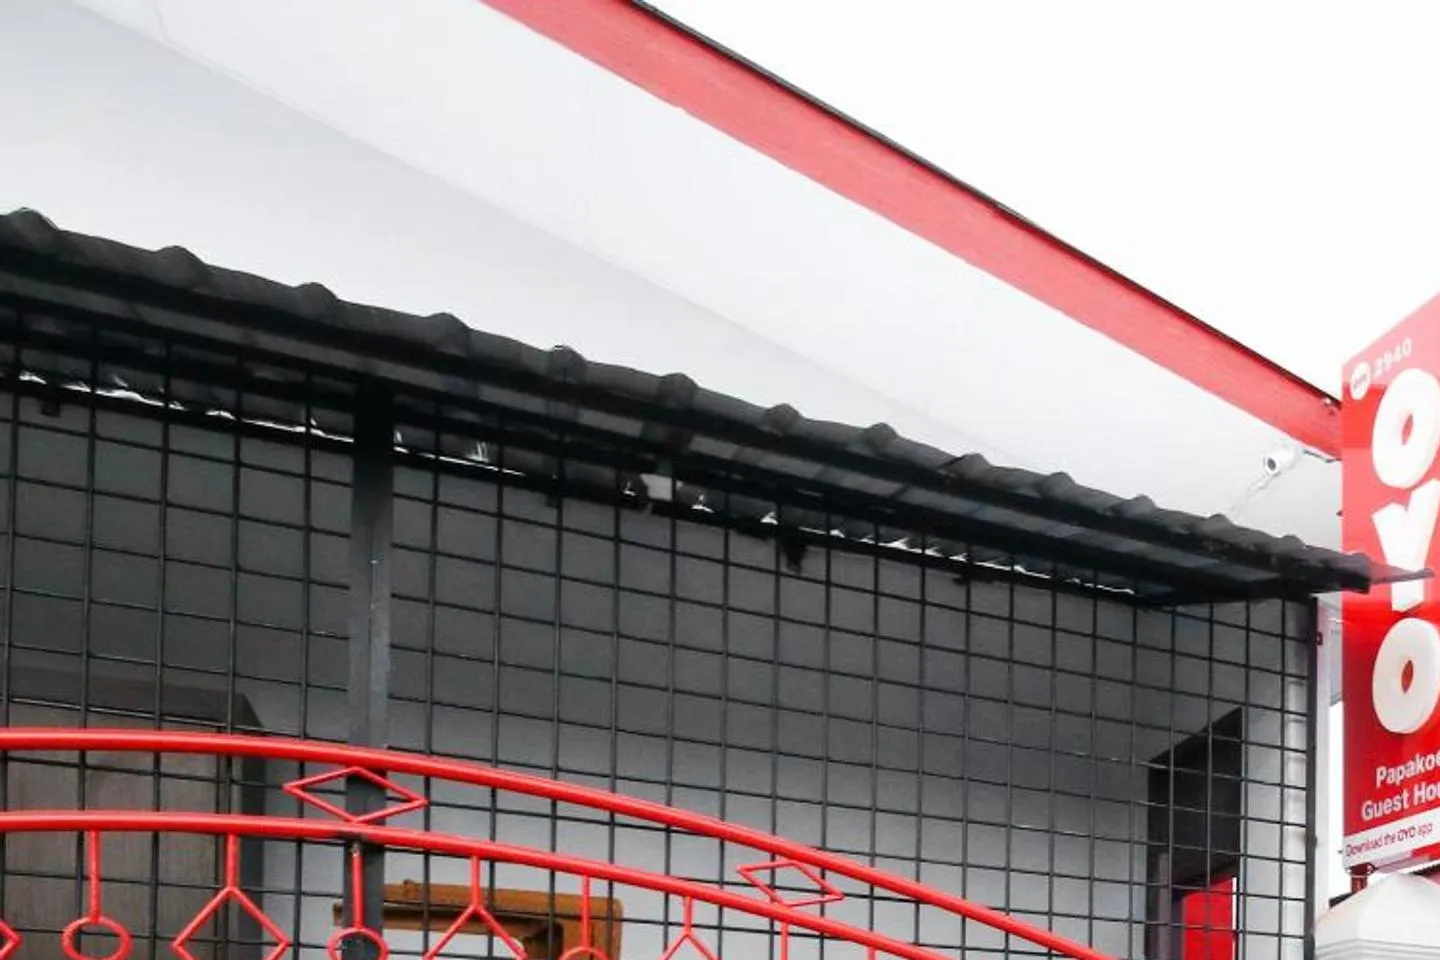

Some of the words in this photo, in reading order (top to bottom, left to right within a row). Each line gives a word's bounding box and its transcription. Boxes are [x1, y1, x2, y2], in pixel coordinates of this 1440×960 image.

[1361, 788, 1411, 822] Guest
[1345, 836, 1383, 857] Download
[1383, 832, 1397, 847] the
[1397, 825, 1416, 842] OYO
[1418, 822, 1434, 838] app
